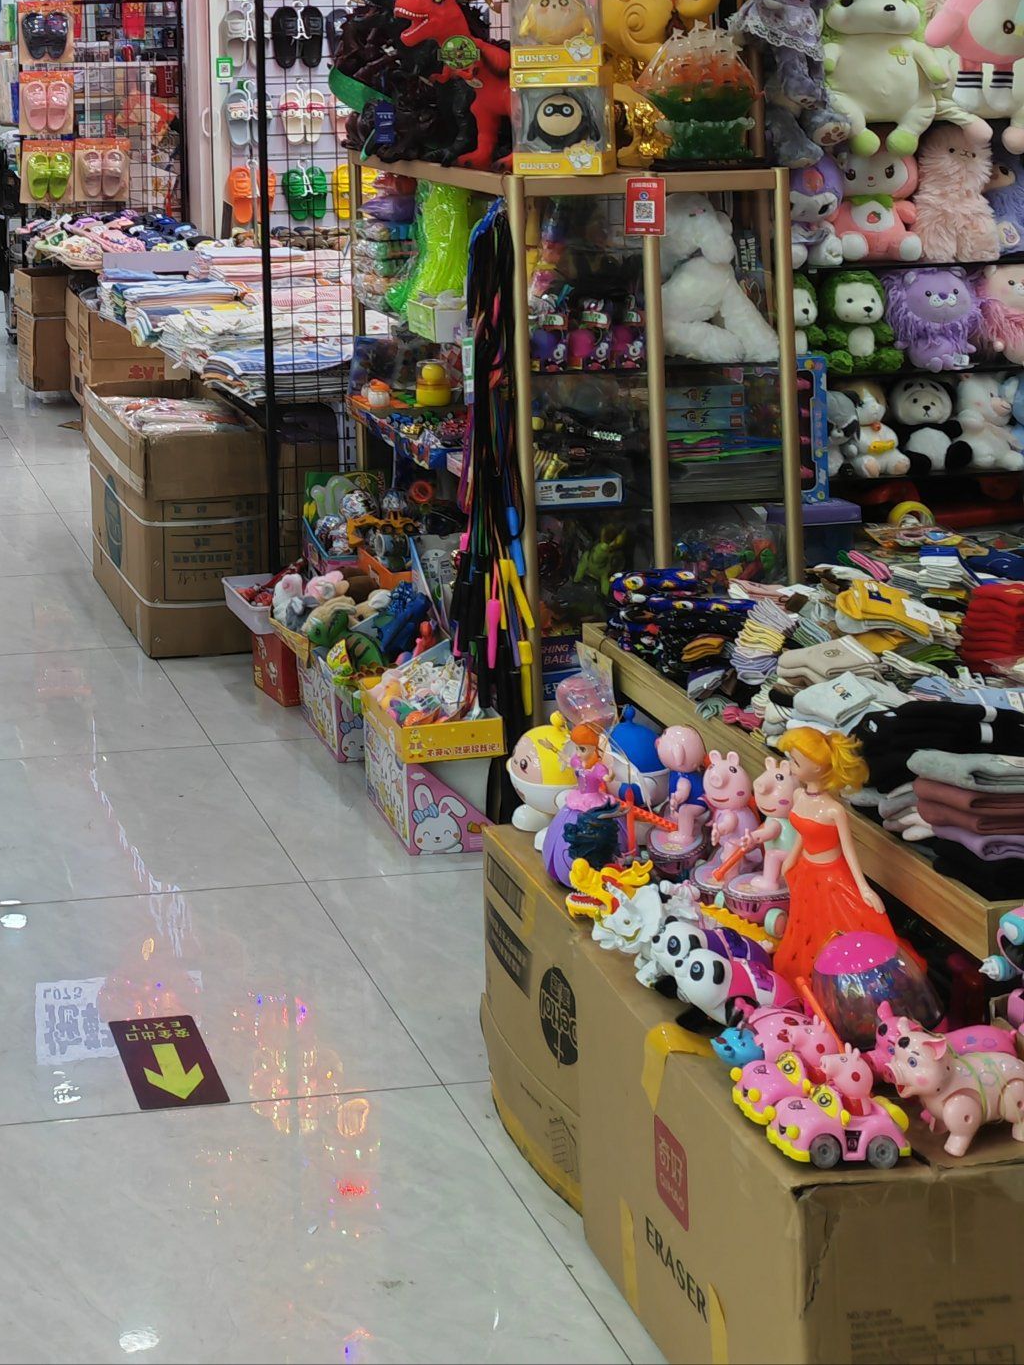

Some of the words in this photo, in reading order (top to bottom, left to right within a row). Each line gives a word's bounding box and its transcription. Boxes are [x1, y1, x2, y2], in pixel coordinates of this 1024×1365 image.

[129, 1021, 182, 1031] EXIT
[125, 1028, 191, 1042] 安全出口
[644, 1215, 709, 1324] ERASER
